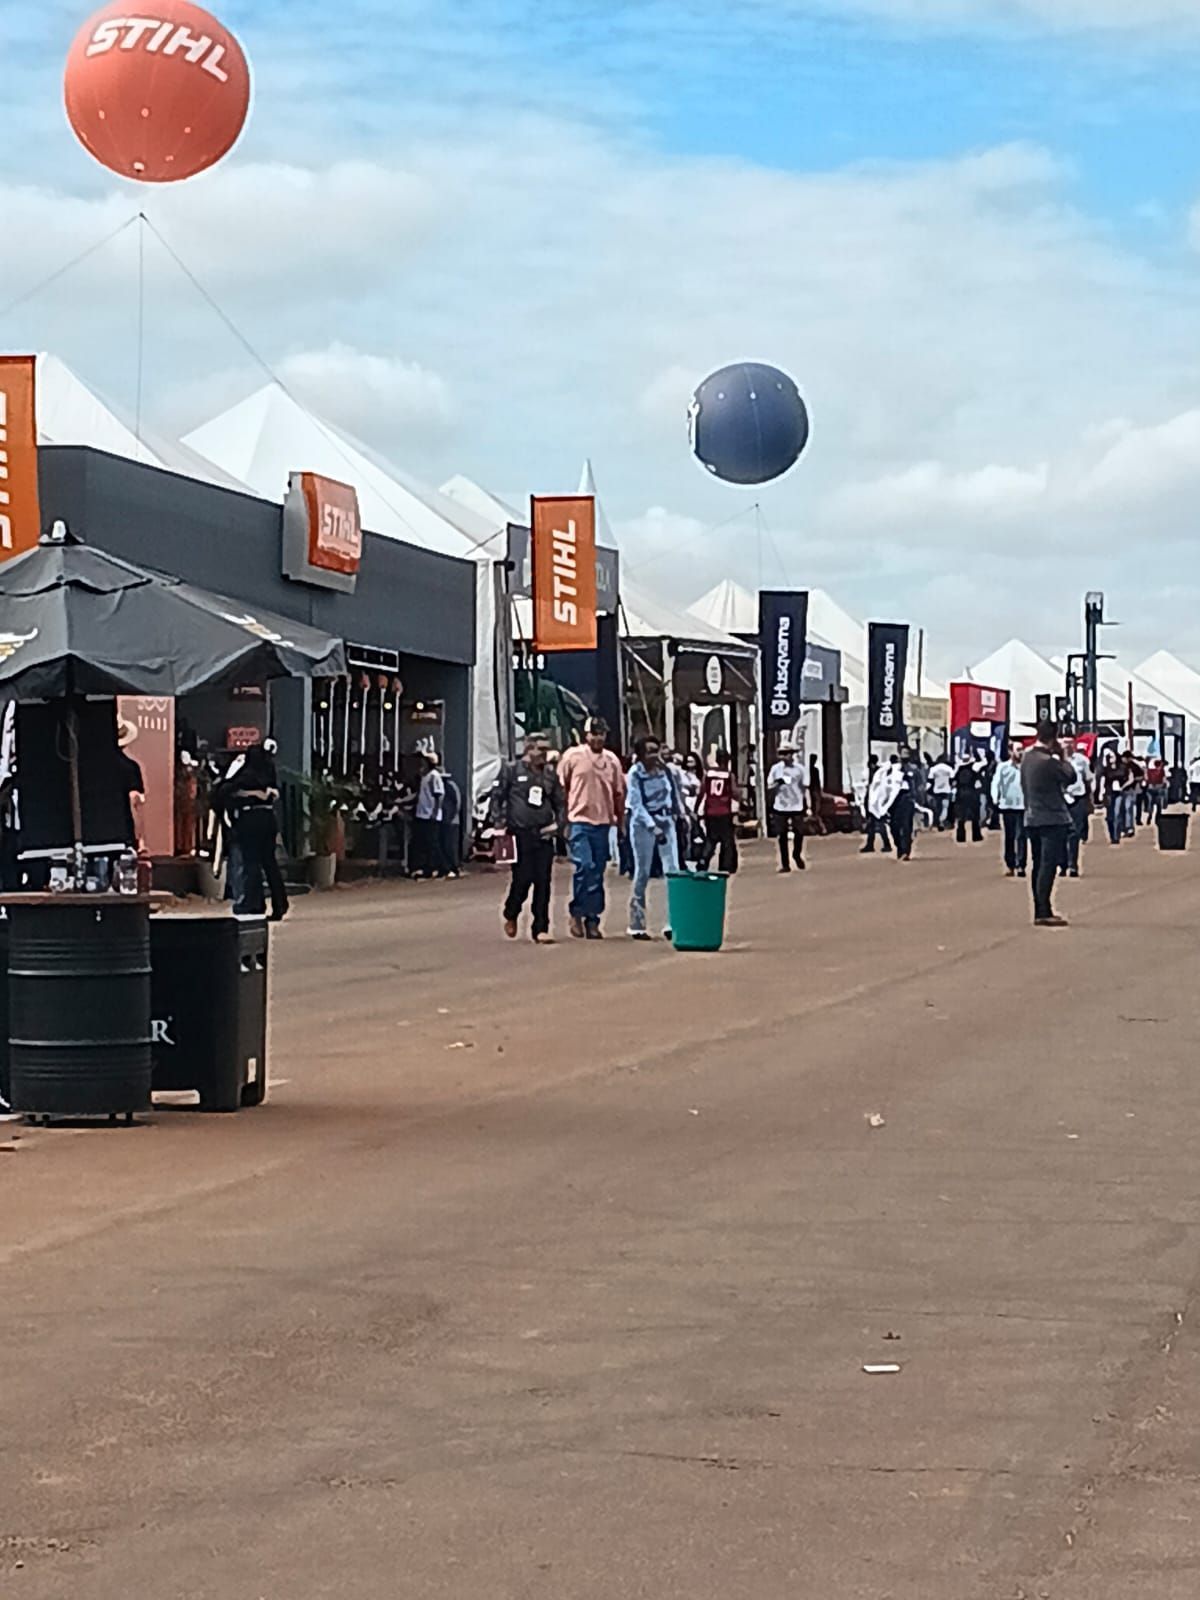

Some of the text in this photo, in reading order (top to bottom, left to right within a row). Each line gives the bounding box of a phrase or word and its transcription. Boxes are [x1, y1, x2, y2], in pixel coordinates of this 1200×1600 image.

[86, 17, 229, 83] STIHL
[322, 503, 359, 546] STIHL
[552, 519, 577, 626] STIHL
[773, 616, 791, 699] Husqvarna
